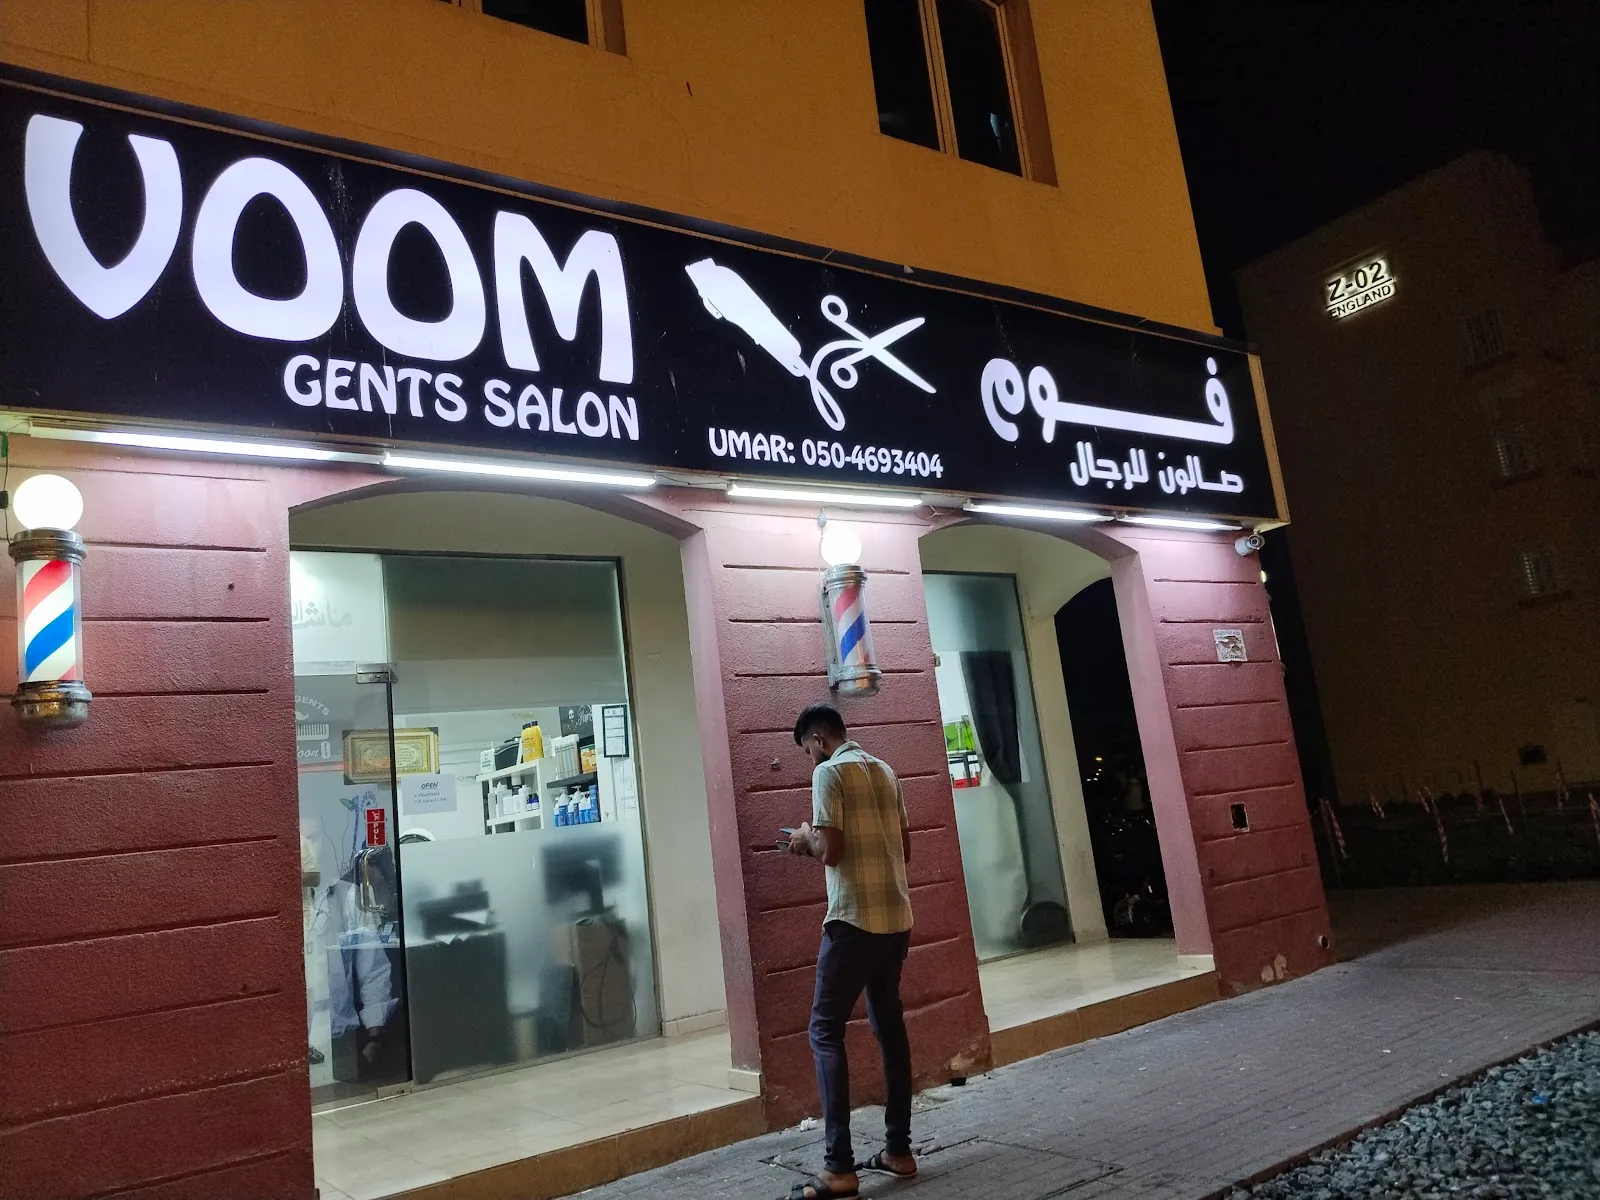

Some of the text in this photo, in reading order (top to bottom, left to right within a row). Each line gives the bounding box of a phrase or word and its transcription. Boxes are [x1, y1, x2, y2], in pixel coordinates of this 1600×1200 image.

[25, 114, 634, 384] VOOM
[1327, 261, 1386, 302] Z-02
[1327, 285, 1392, 319] ENGLAND
[284, 354, 639, 441] GENTS SALON
[981, 357, 1234, 445] فوم
[708, 427, 944, 479] UMAR: 050-4693404
[1069, 440, 1244, 495] صالون للرجال
[421, 781, 439, 790] OPEN
